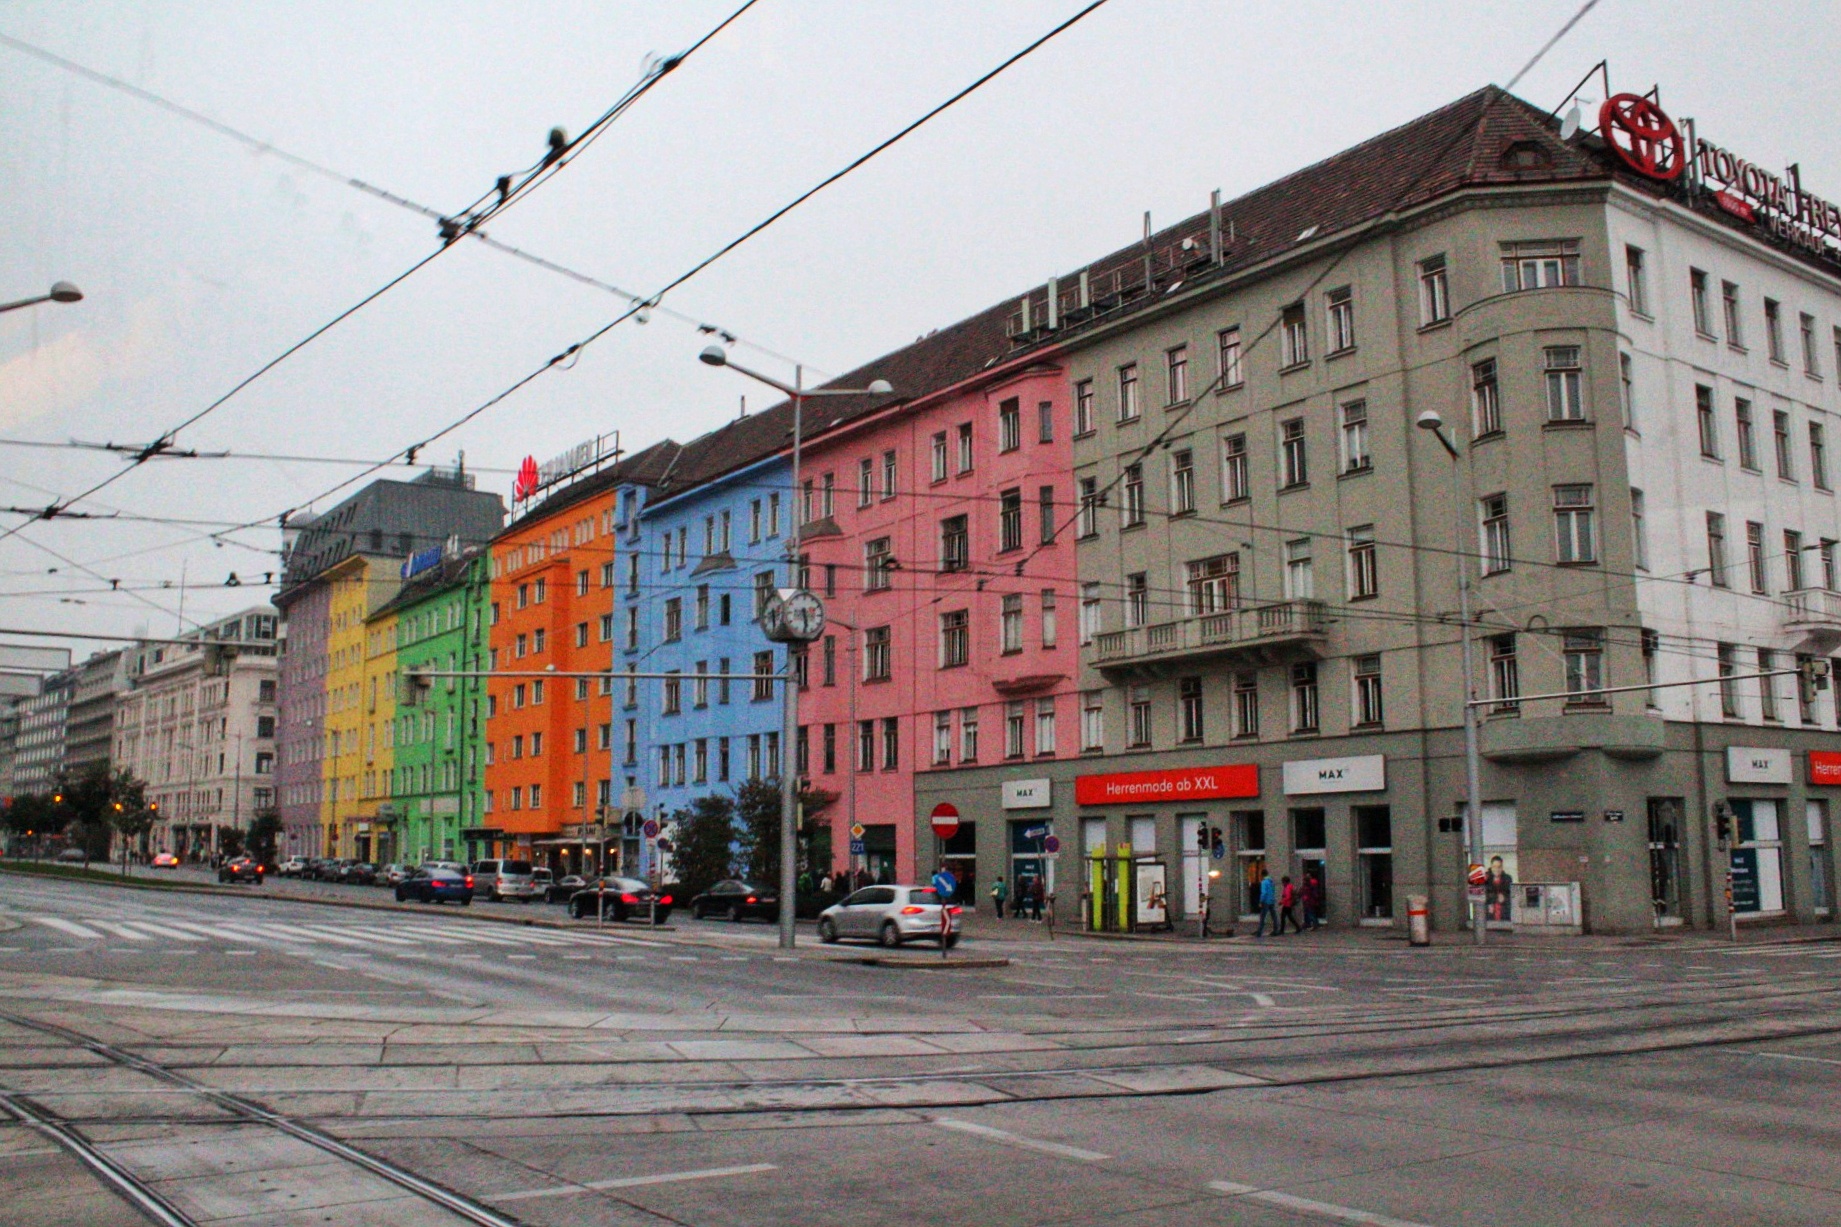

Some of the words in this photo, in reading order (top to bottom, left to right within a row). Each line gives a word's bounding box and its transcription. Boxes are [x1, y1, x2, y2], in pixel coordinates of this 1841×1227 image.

[1697, 138, 1793, 216] TOYOTA
[1752, 760, 1768, 768] MAX
[1319, 769, 1343, 779] MAX
[1106, 779, 1173, 794] Herrenmode
[1176, 777, 1191, 791] ab
[1195, 776, 1218, 790] XXL
[1016, 789, 1033, 797] MAX
[852, 843, 864, 851] 221
